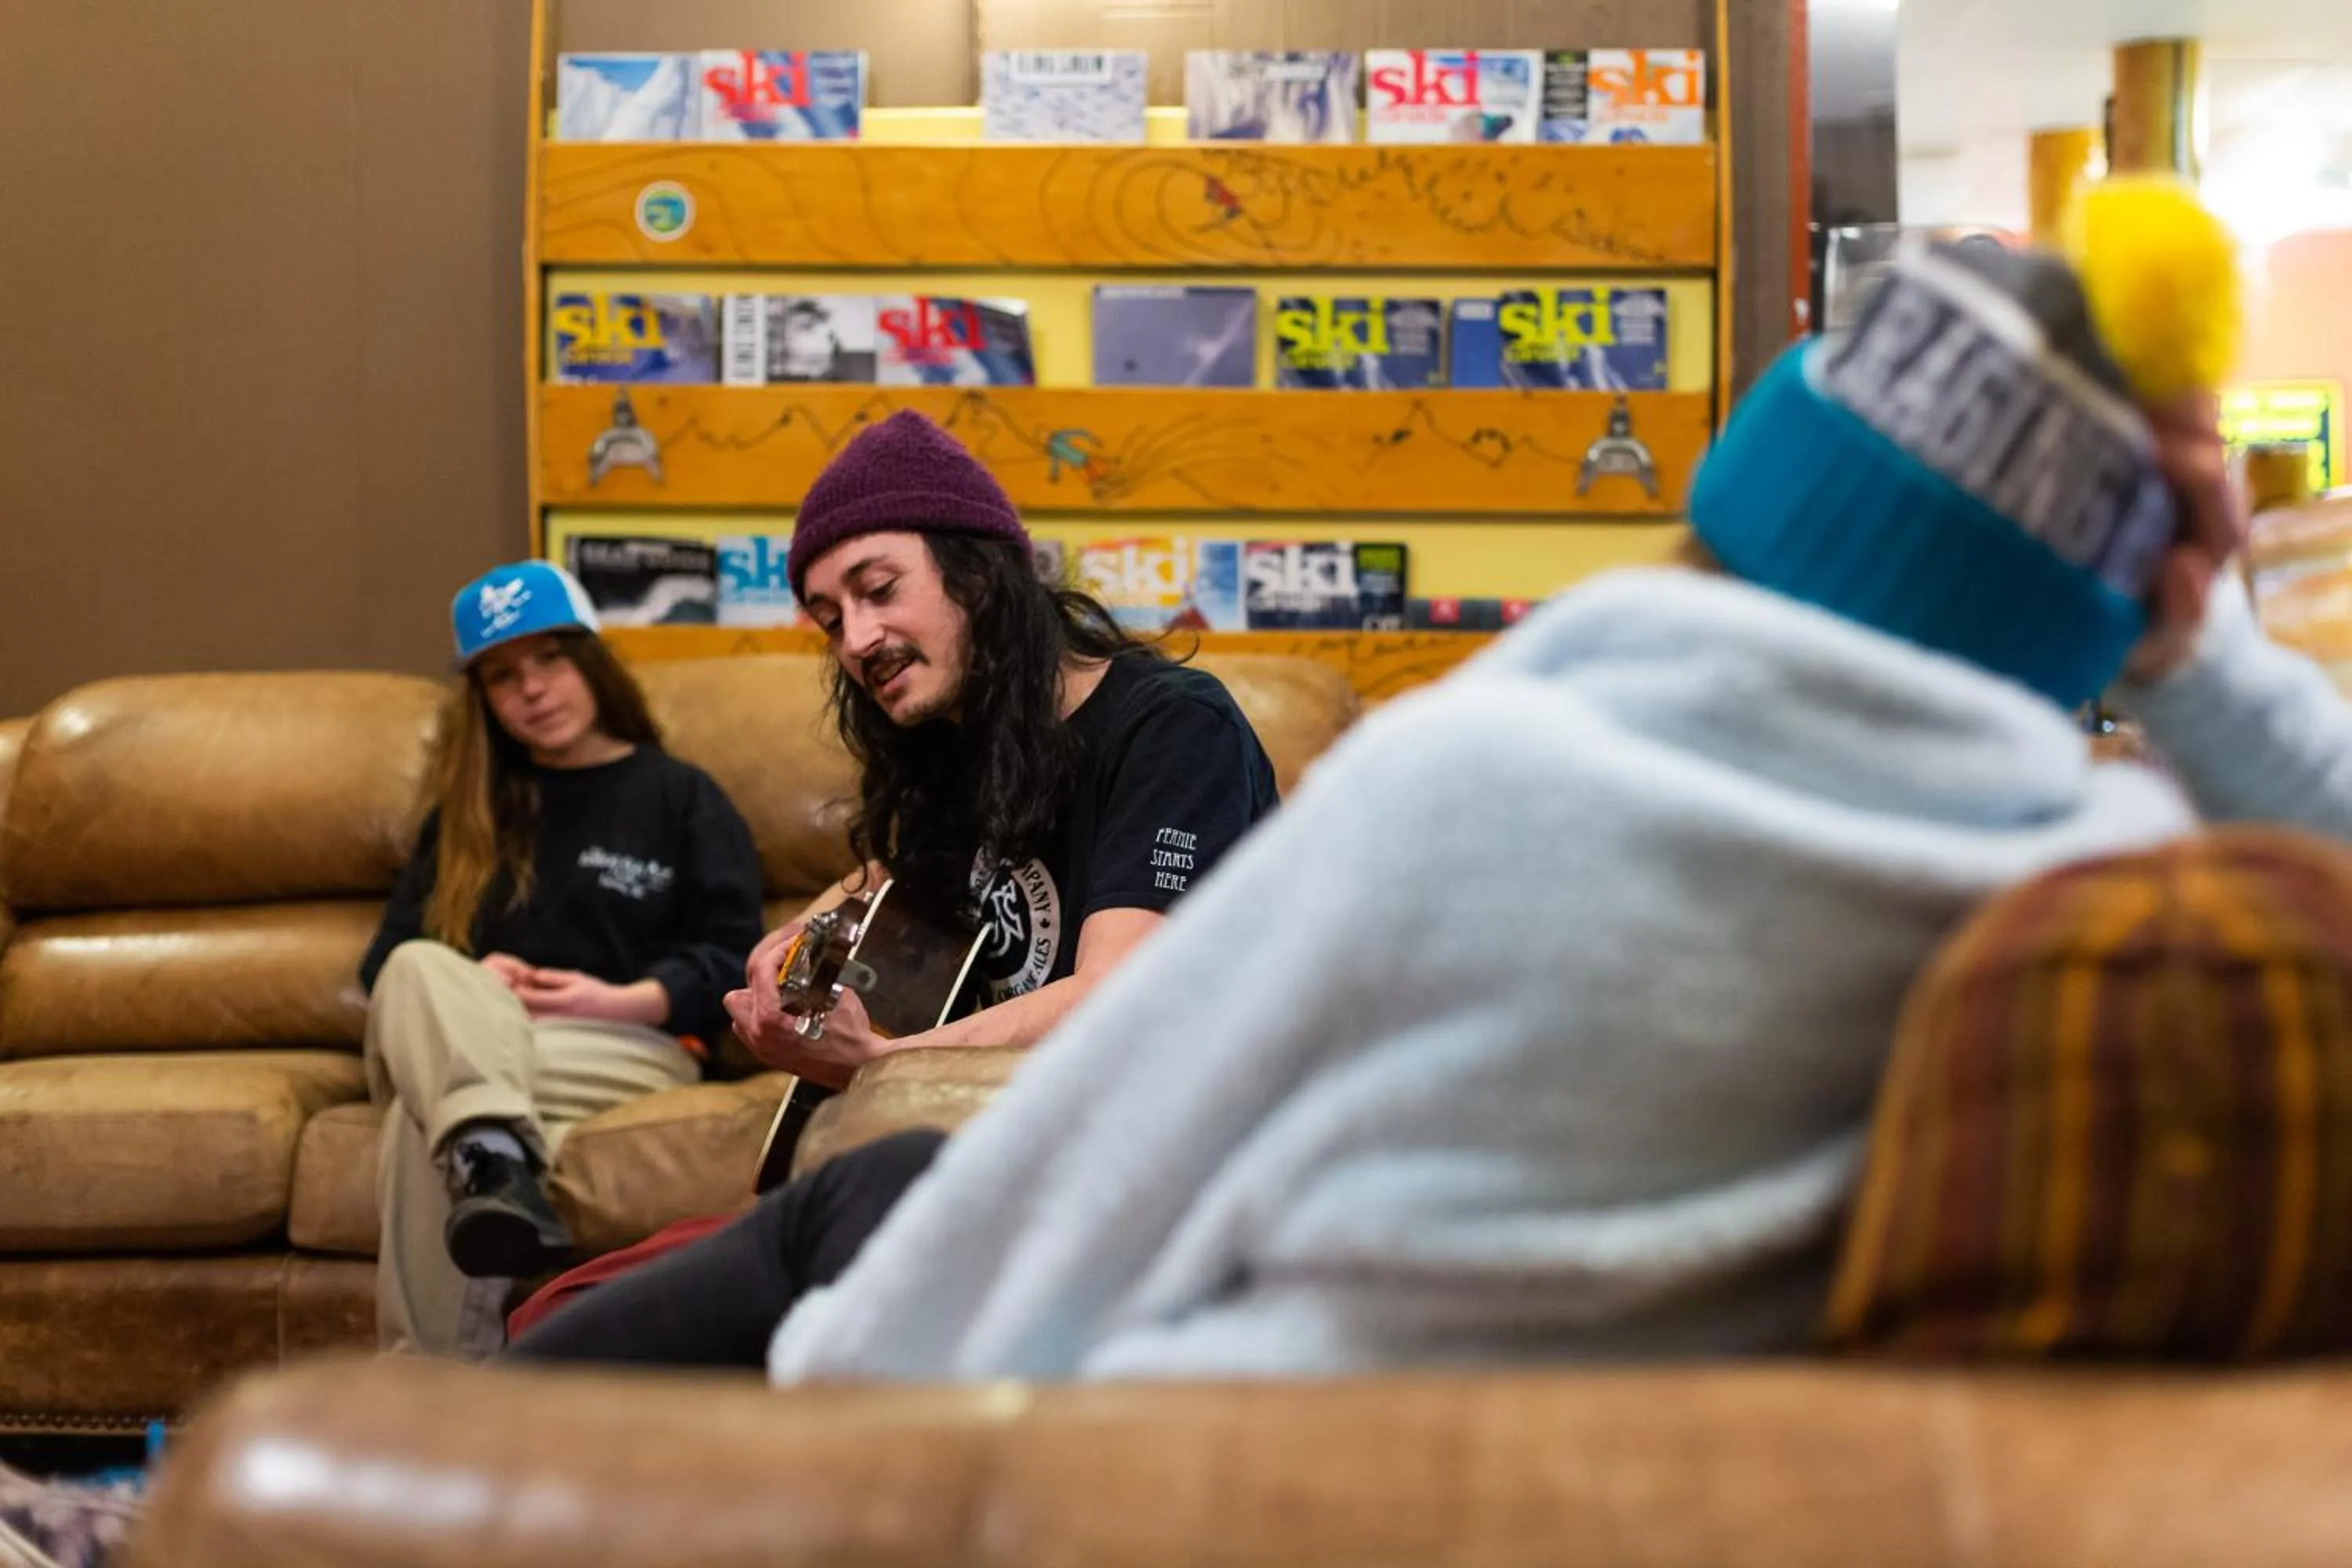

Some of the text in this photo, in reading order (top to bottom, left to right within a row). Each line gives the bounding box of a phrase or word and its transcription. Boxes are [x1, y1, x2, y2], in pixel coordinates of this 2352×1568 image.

[703, 50, 811, 107] ski
[1370, 49, 1481, 107] ski
[1588, 49, 1700, 107] ski
[554, 295, 662, 350] ski
[878, 296, 985, 351] ski
[1277, 296, 1390, 356] ski
[1498, 288, 1616, 348] ski
[719, 536, 787, 591] sk
[1082, 535, 1189, 593] ski
[1247, 541, 1359, 597] ski
[1150, 849, 1194, 869] STARTS
[1154, 872, 1187, 891] HERE
[1022, 863, 1051, 913] PANY
